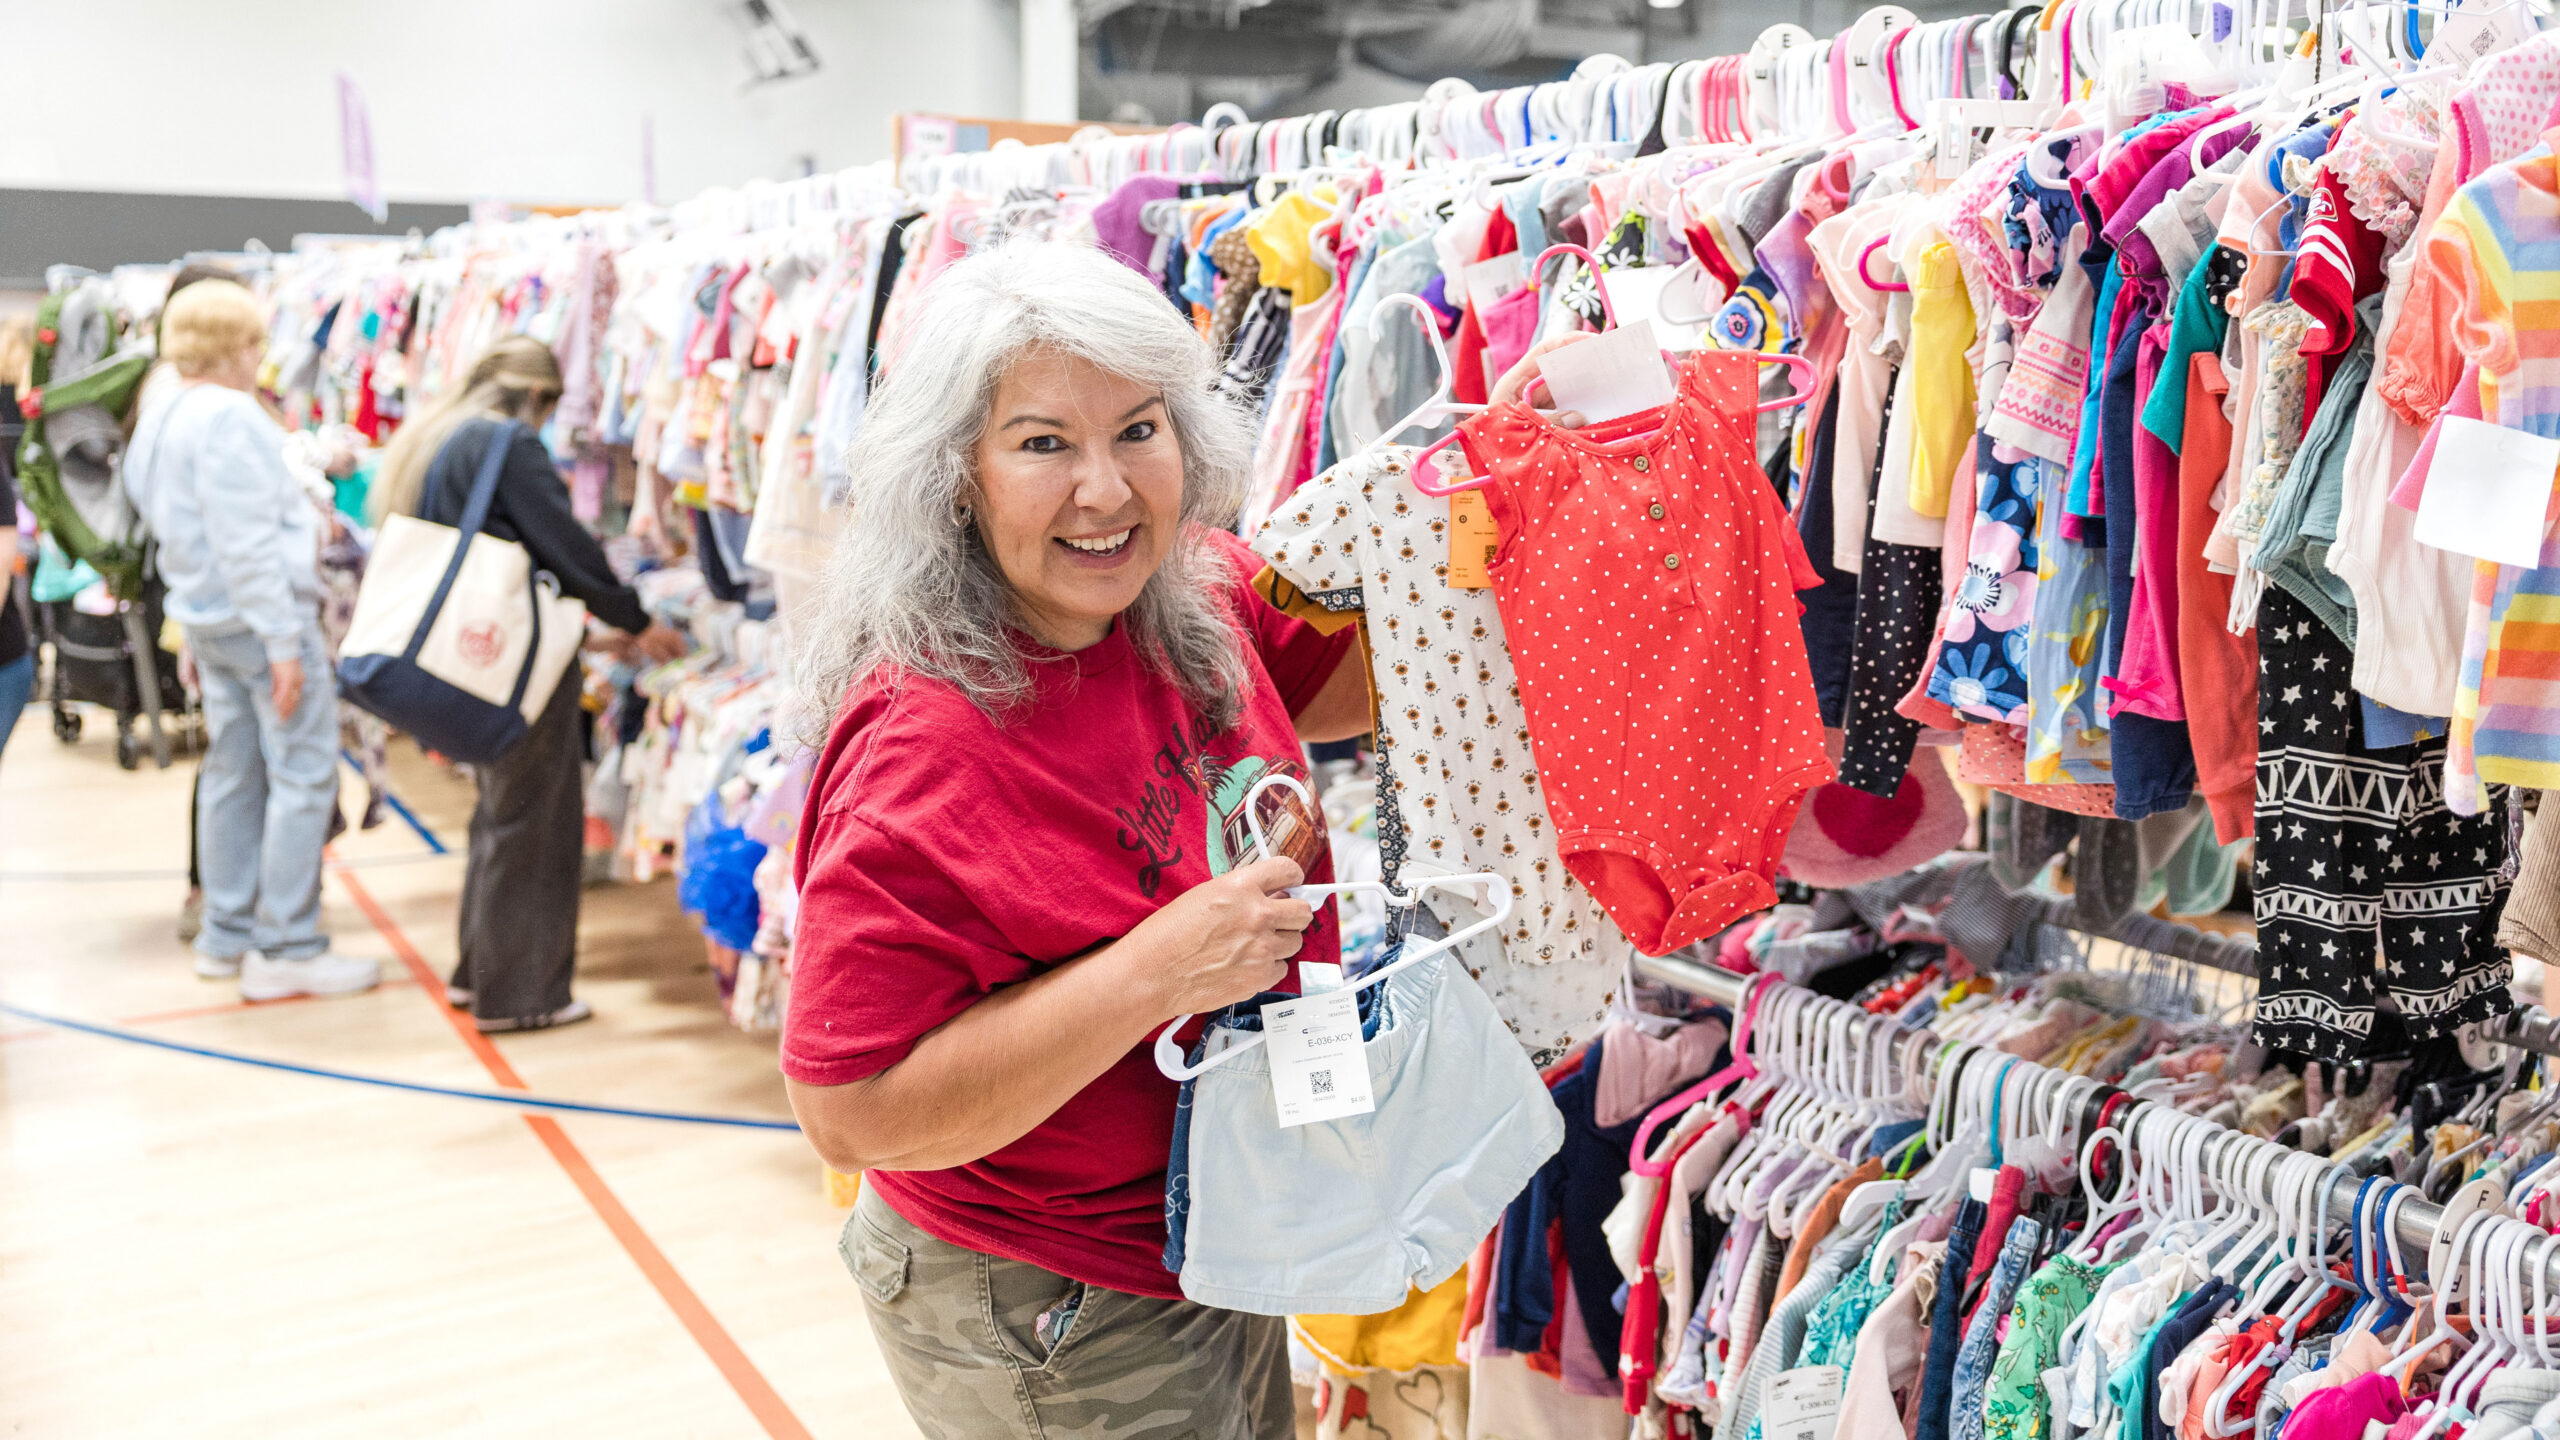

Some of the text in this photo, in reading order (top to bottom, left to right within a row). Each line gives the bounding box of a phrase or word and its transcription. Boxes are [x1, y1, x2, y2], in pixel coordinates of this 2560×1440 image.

[1884, 15, 1893, 32] F
[1782, 33, 1792, 49] E
[1854, 55, 1868, 67] F
[1754, 68, 1768, 80] E
[1307, 1032, 1353, 1047] E-036-XCY
[2476, 1189, 2490, 1208] F
[2440, 1230, 2451, 1245] F
[2450, 1274, 2463, 1293] F
